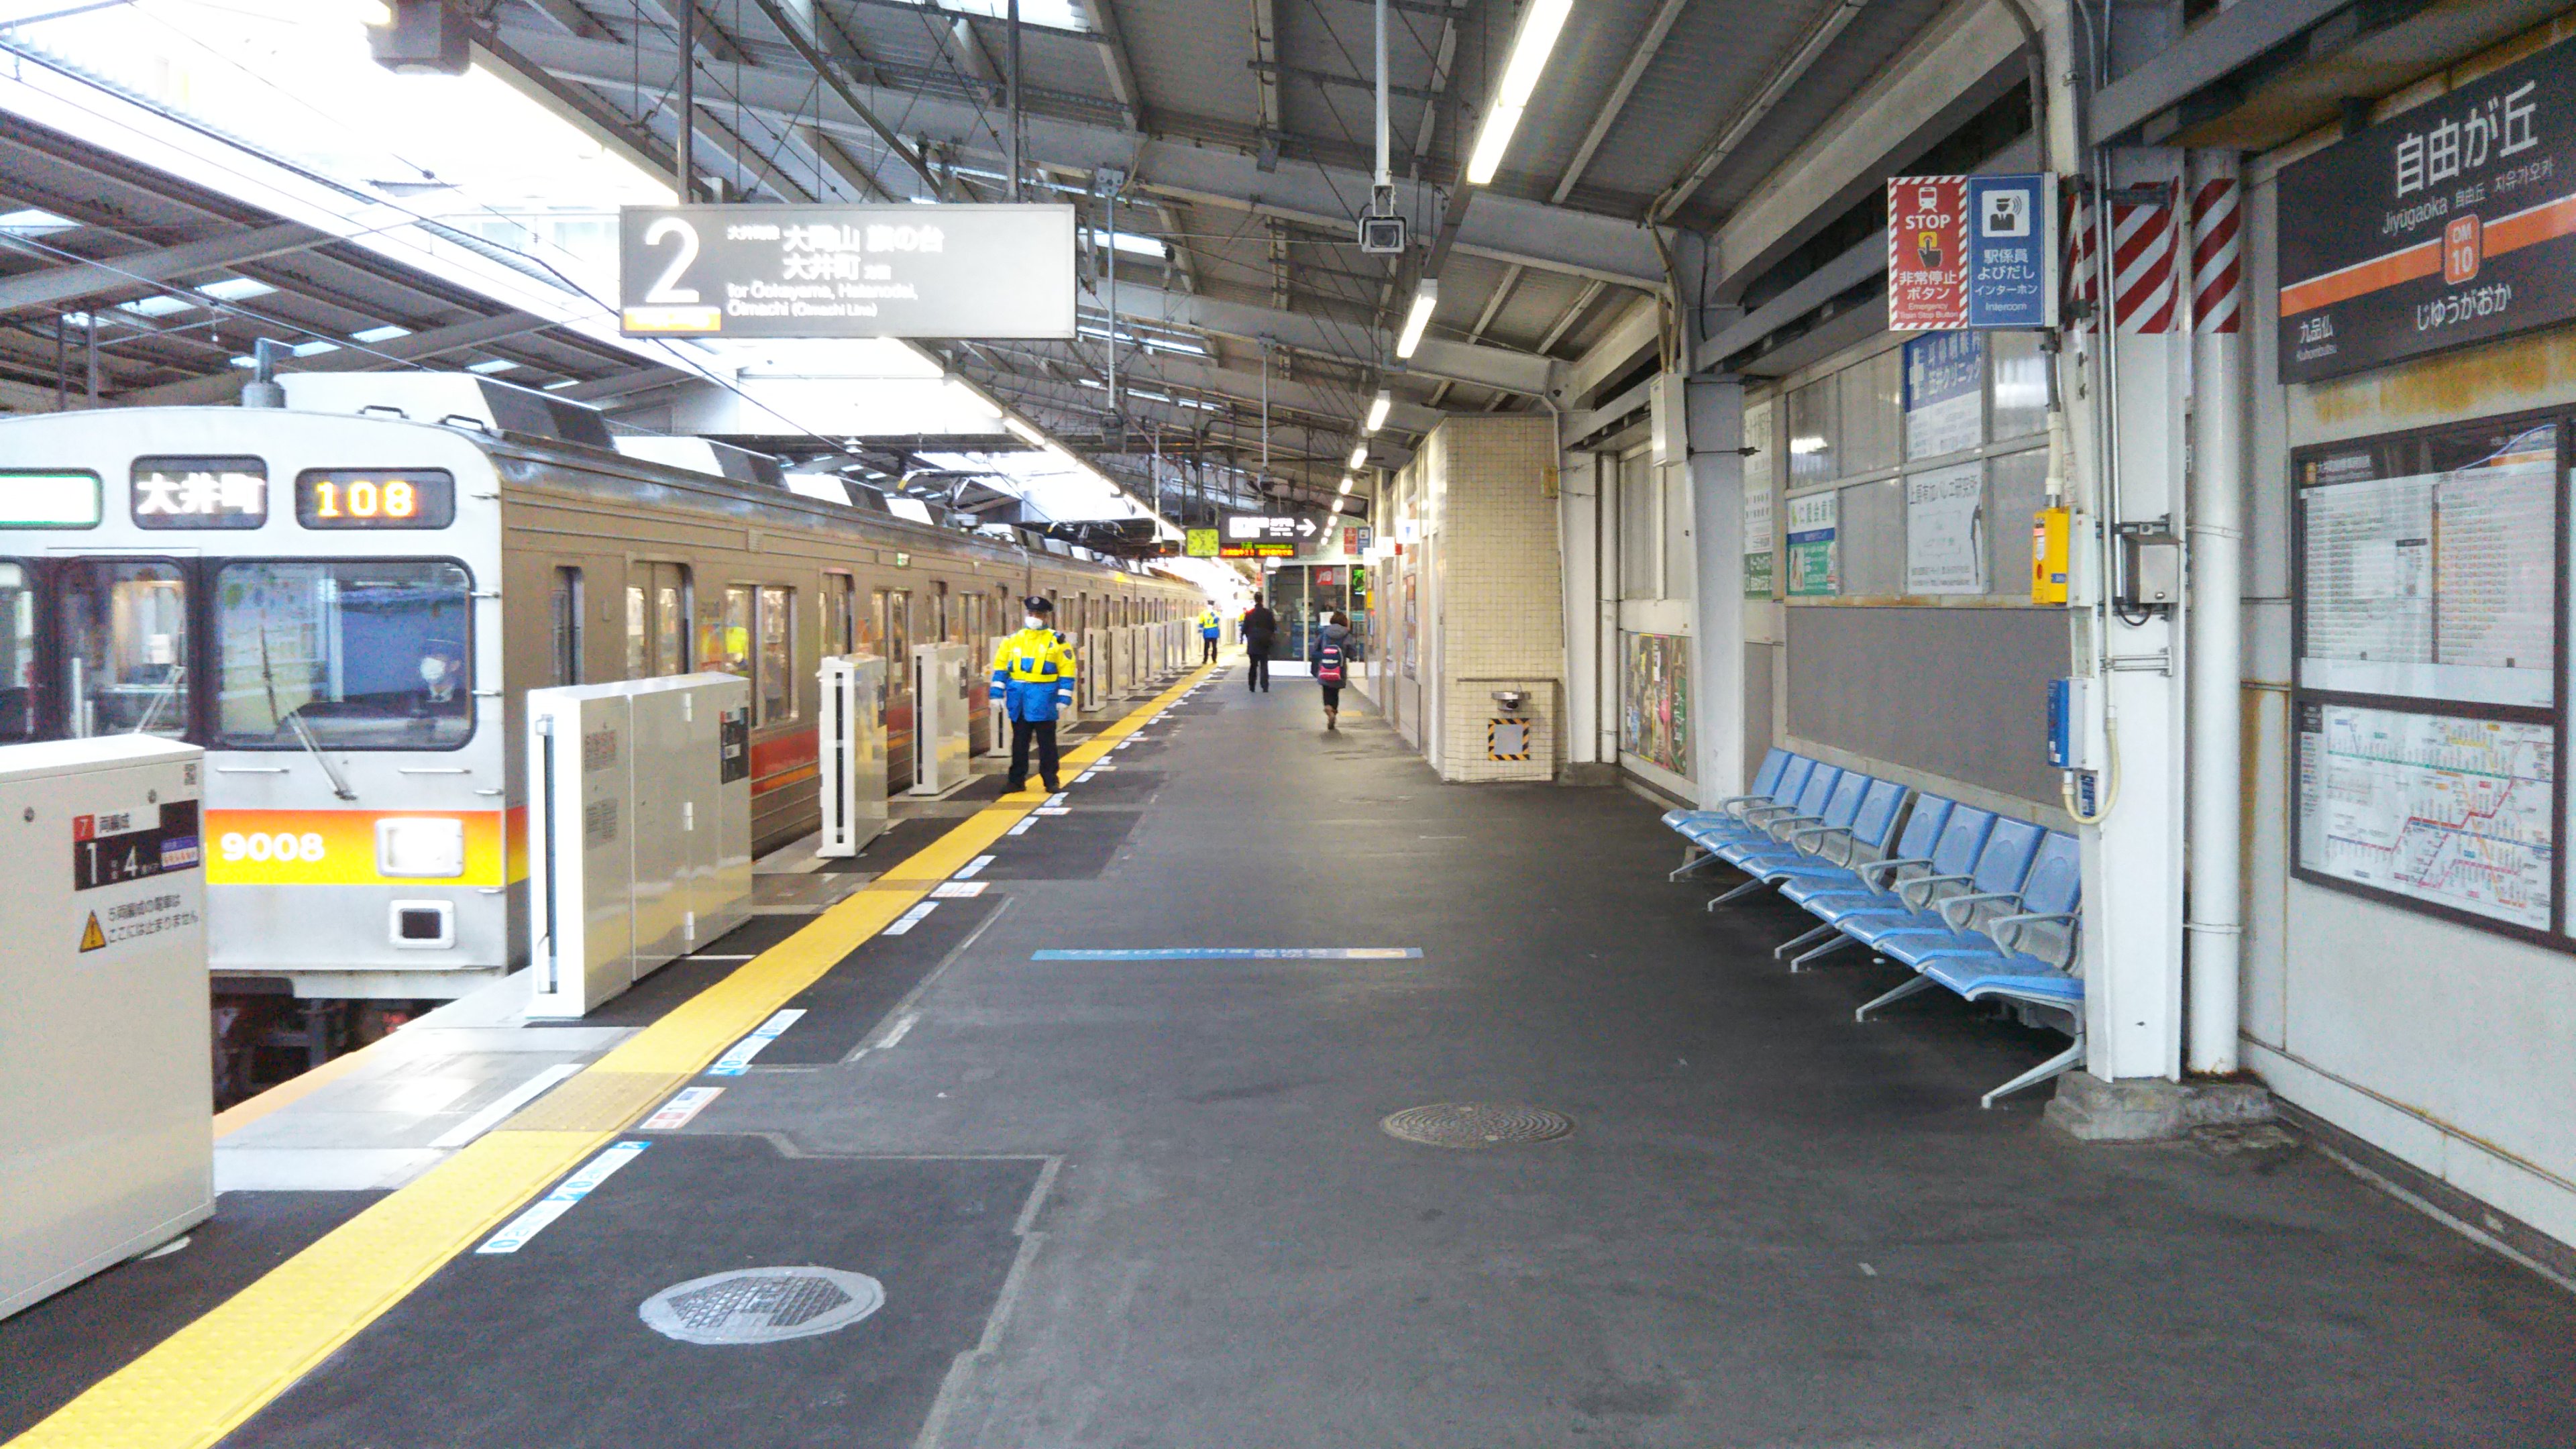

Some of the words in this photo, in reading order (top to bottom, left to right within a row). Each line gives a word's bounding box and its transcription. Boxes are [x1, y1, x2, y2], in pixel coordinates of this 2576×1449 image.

[2397, 80, 2538, 198] 自由が丘
[2456, 182, 2486, 209] 自由丘
[1905, 214, 1951, 229] STOP
[2453, 222, 2473, 244] OM
[645, 217, 700, 303] 2
[783, 252, 861, 280] 大井町
[1984, 248, 2029, 264] 駅係員
[2453, 246, 2473, 275] 10
[1899, 270, 1957, 285] 非常停止
[1978, 265, 2035, 280] よびだし
[1907, 287, 1950, 300] ボタン
[1974, 284, 2038, 296] インターホン
[1986, 302, 2027, 311] Intercom
[2418, 282, 2512, 331] じゆうがおか
[2300, 314, 2333, 344] 九品仏
[138, 472, 266, 515] 大井町
[317, 480, 415, 517] 108
[220, 832, 325, 862] 9008
